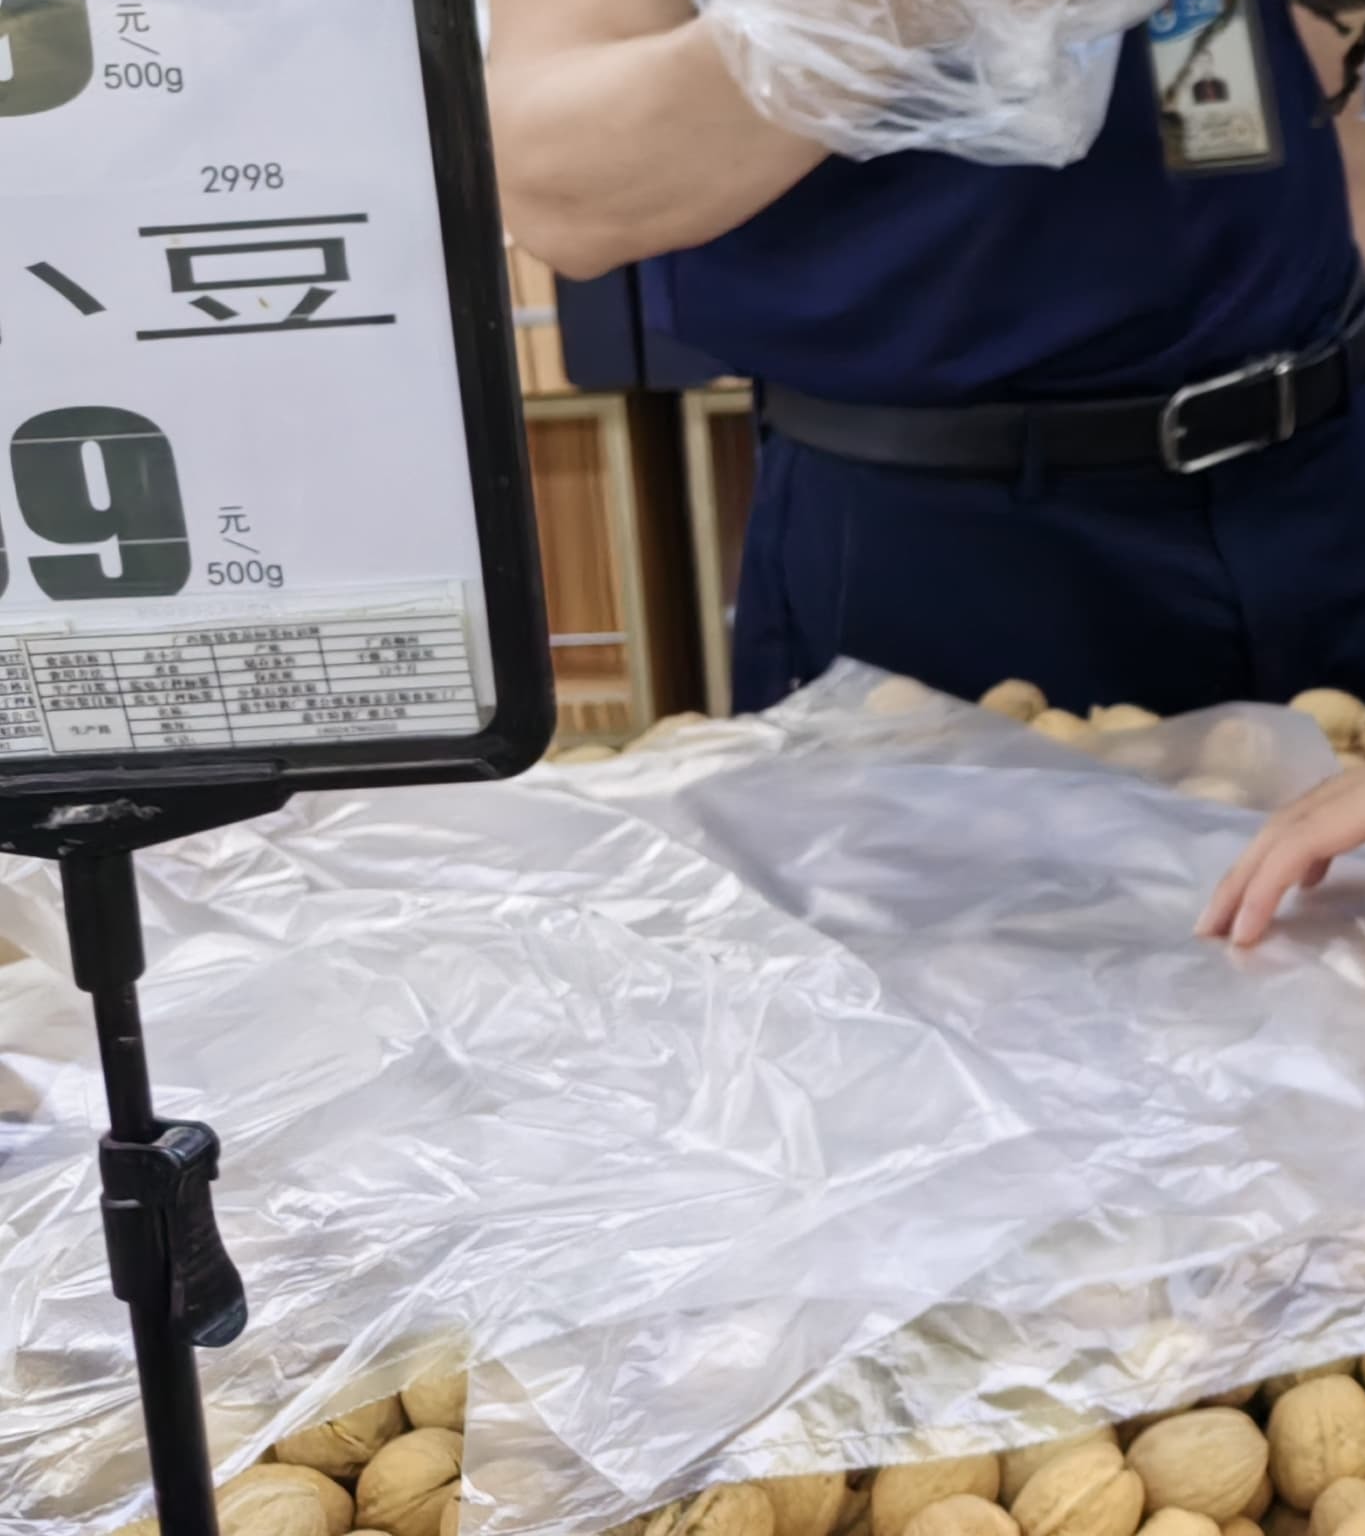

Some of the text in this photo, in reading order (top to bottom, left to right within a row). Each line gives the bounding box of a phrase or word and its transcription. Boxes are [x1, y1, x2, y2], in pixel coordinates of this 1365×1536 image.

[116, 3, 150, 33] 元
[103, 61, 184, 93] 500g
[200, 162, 285, 193] 2998
[0, 405, 192, 601] 9
[218, 506, 251, 534] 元
[207, 560, 284, 587] 500g
